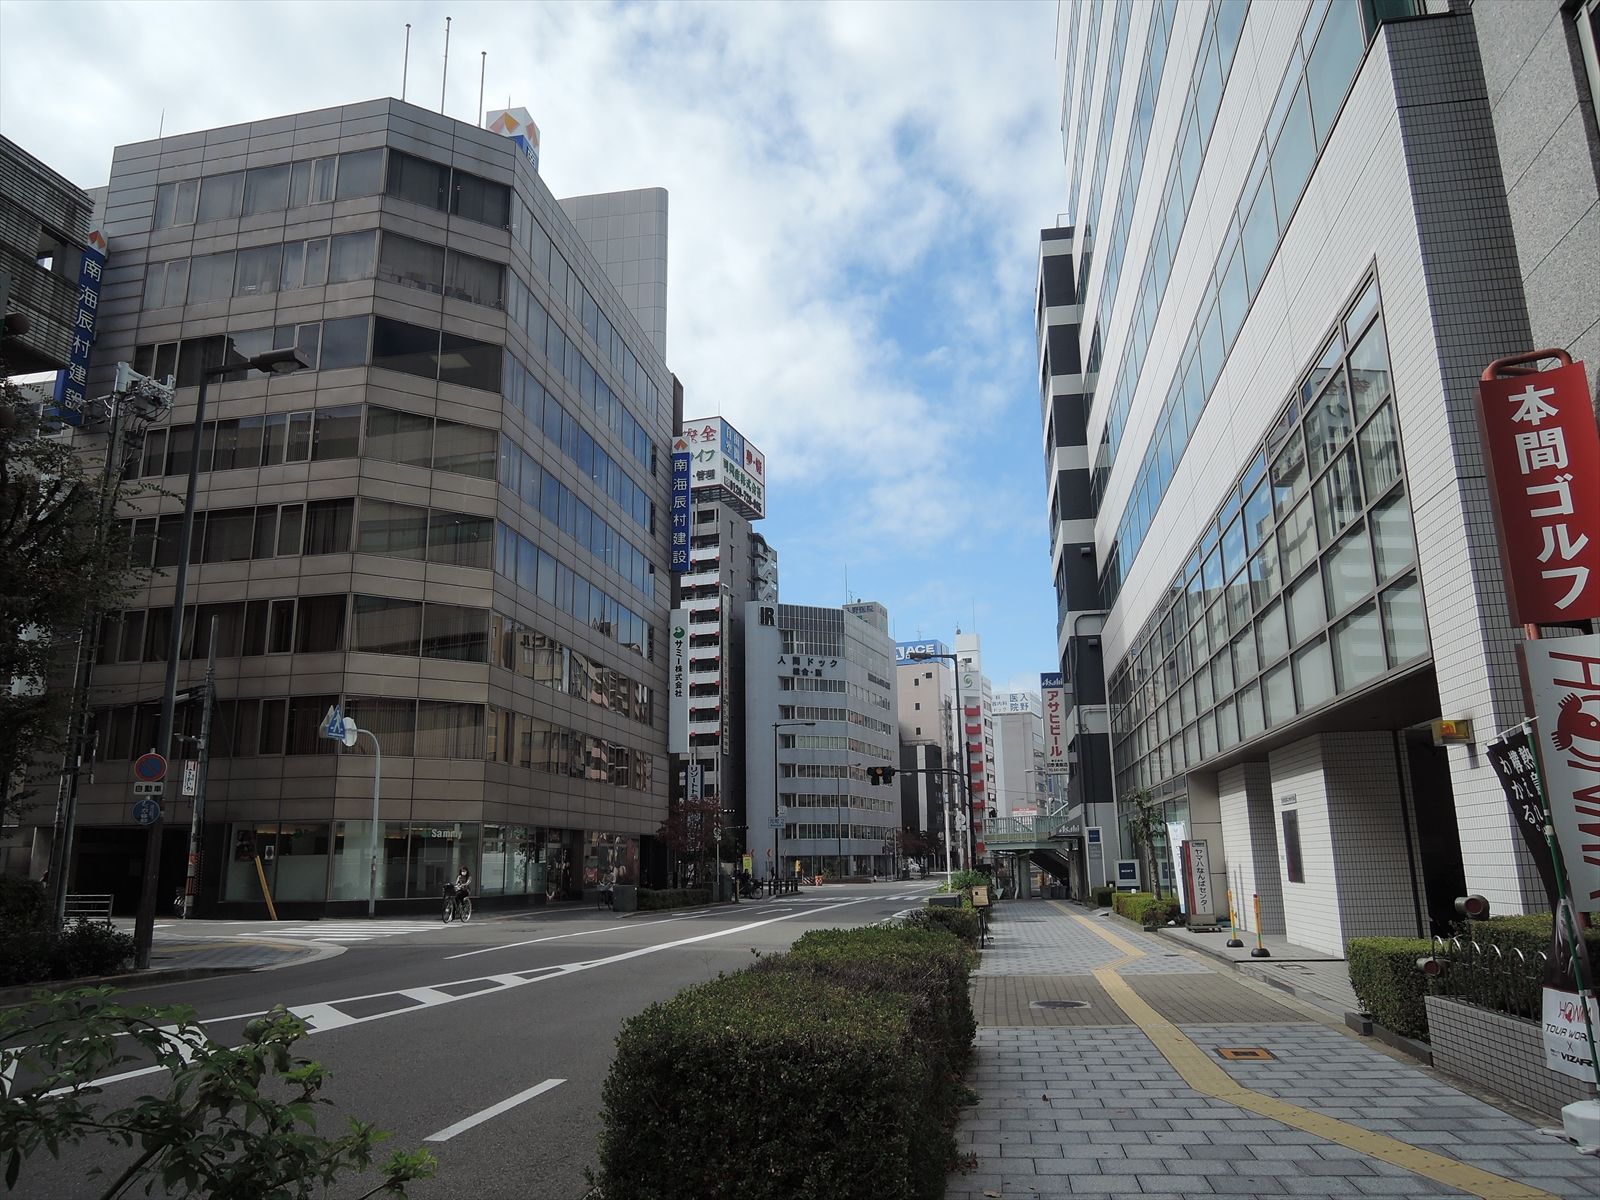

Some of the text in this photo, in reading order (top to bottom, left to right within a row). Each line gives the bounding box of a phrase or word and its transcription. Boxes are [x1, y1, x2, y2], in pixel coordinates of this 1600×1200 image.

[65, 257, 103, 414] 南海辰村建設
[673, 459, 688, 564] 南海辰村建設
[1508, 384, 1590, 610] 本間ゴルフ
[673, 640, 683, 698] サミー株式会社
[906, 644, 935, 654] ACE
[1047, 690, 1063, 757] アサヒビール
[431, 828, 463, 840] Sammy
[1195, 848, 1208, 912] ヤマハなんばセンター
[1546, 1023, 1567, 1036] TOUR
